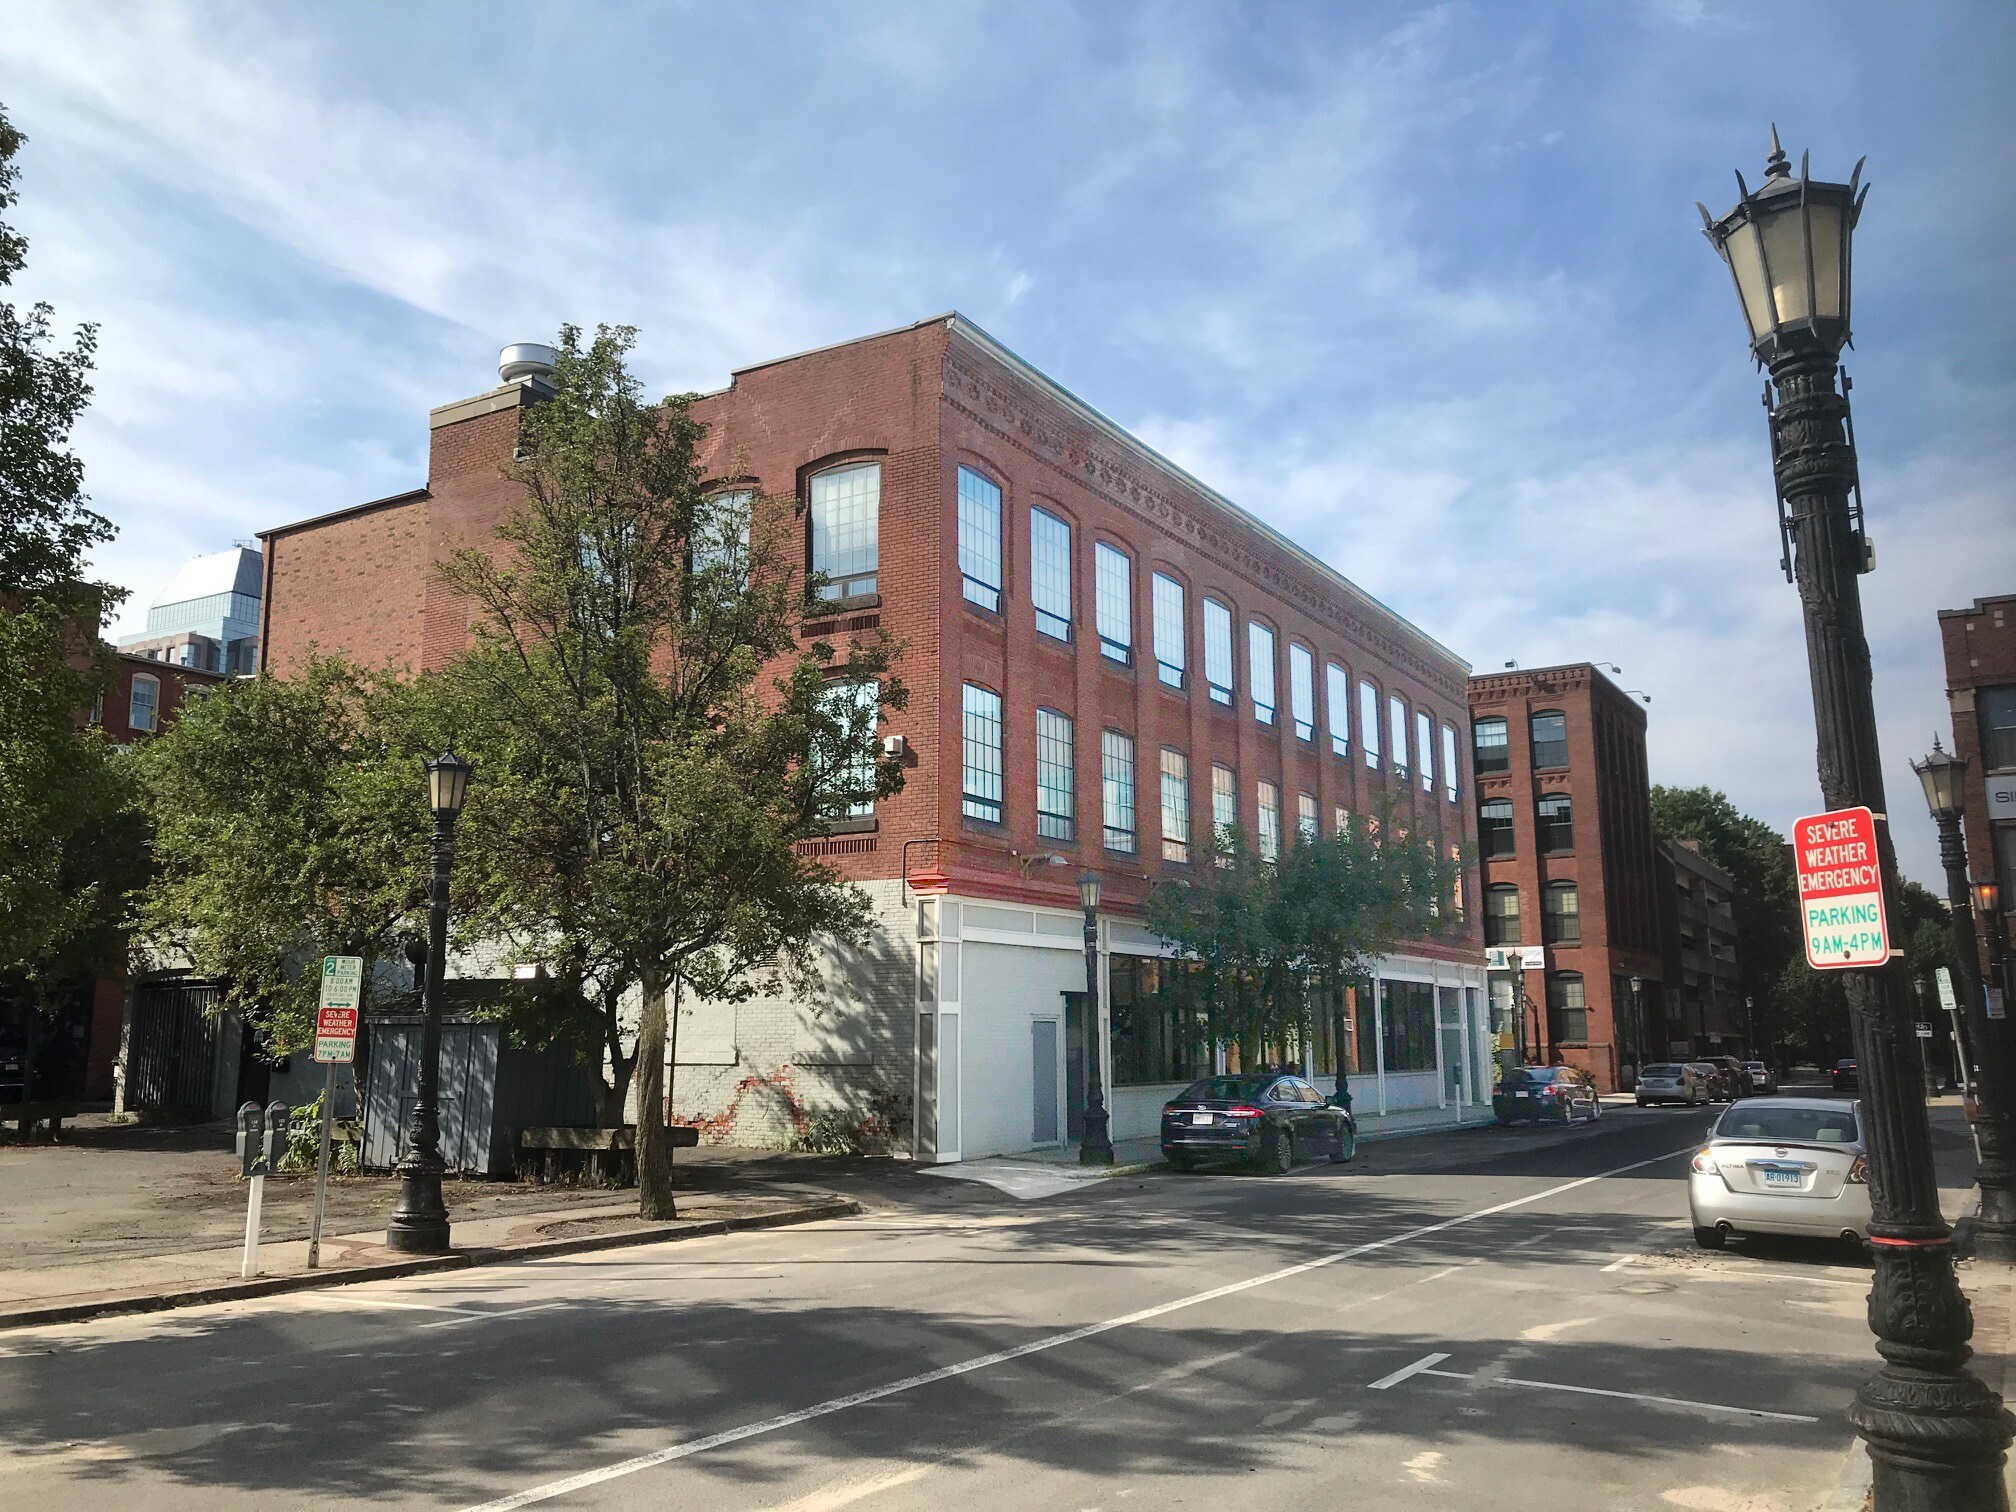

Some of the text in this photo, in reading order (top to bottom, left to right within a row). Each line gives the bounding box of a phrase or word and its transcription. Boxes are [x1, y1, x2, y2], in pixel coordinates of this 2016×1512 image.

[1807, 818, 1858, 844] SEVERE
[1805, 841, 1867, 868] WEATHER
[1800, 864, 1878, 892] EMERGENCY
[1809, 903, 1878, 927] PARKING
[1812, 932, 1883, 955] 9AM-4PM
[326, 962, 335, 975] 2
[348, 985, 357, 993] PM
[325, 1010, 351, 1019] SEVERE
[323, 1018, 353, 1027] WEATHER
[318, 1027, 356, 1036] EMERGENCY
[319, 1040, 352, 1048] PARKING
[318, 1050, 351, 1058] 7PM-7AM
